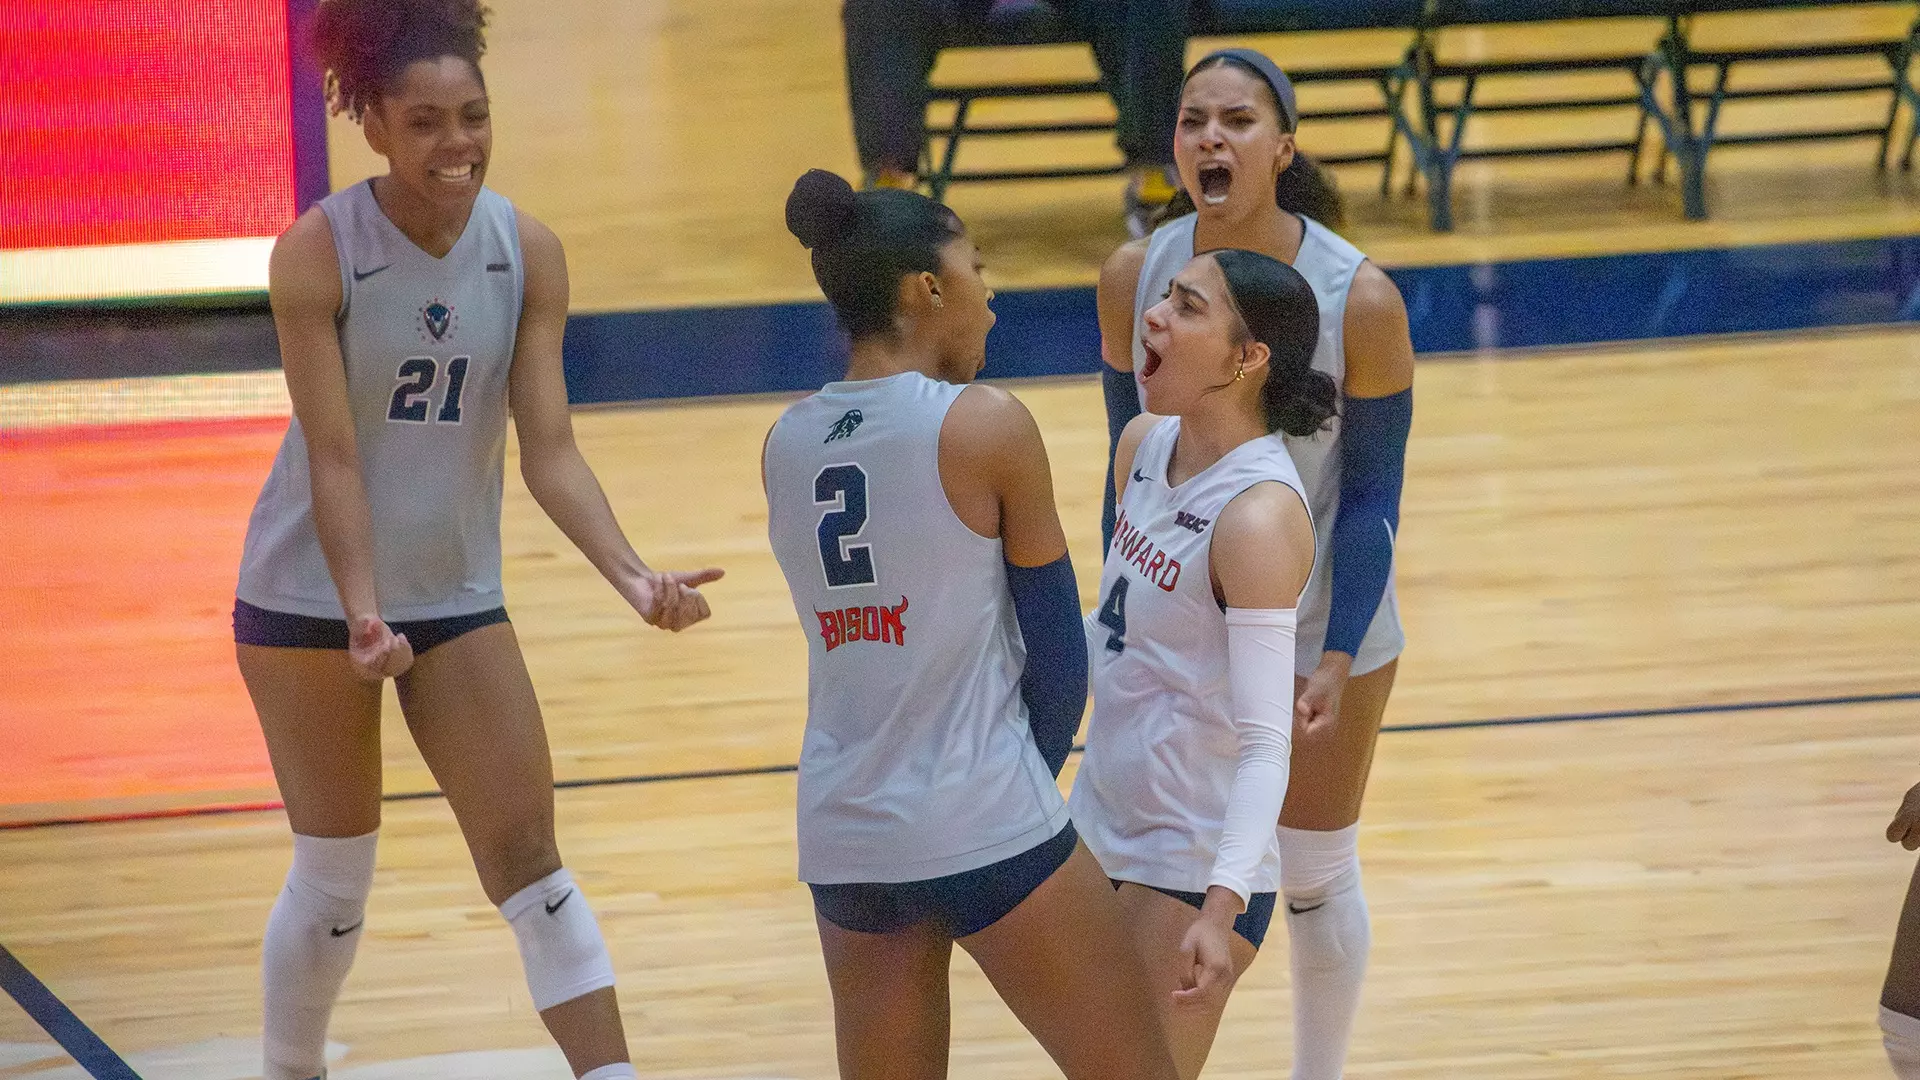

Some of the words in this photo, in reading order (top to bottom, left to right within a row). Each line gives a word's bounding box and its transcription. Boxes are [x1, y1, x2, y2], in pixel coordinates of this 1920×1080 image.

[386, 355, 471, 425] 21
[813, 461, 878, 590] 2
[813, 595, 909, 652] BISON
[1098, 573, 1131, 655] 4
